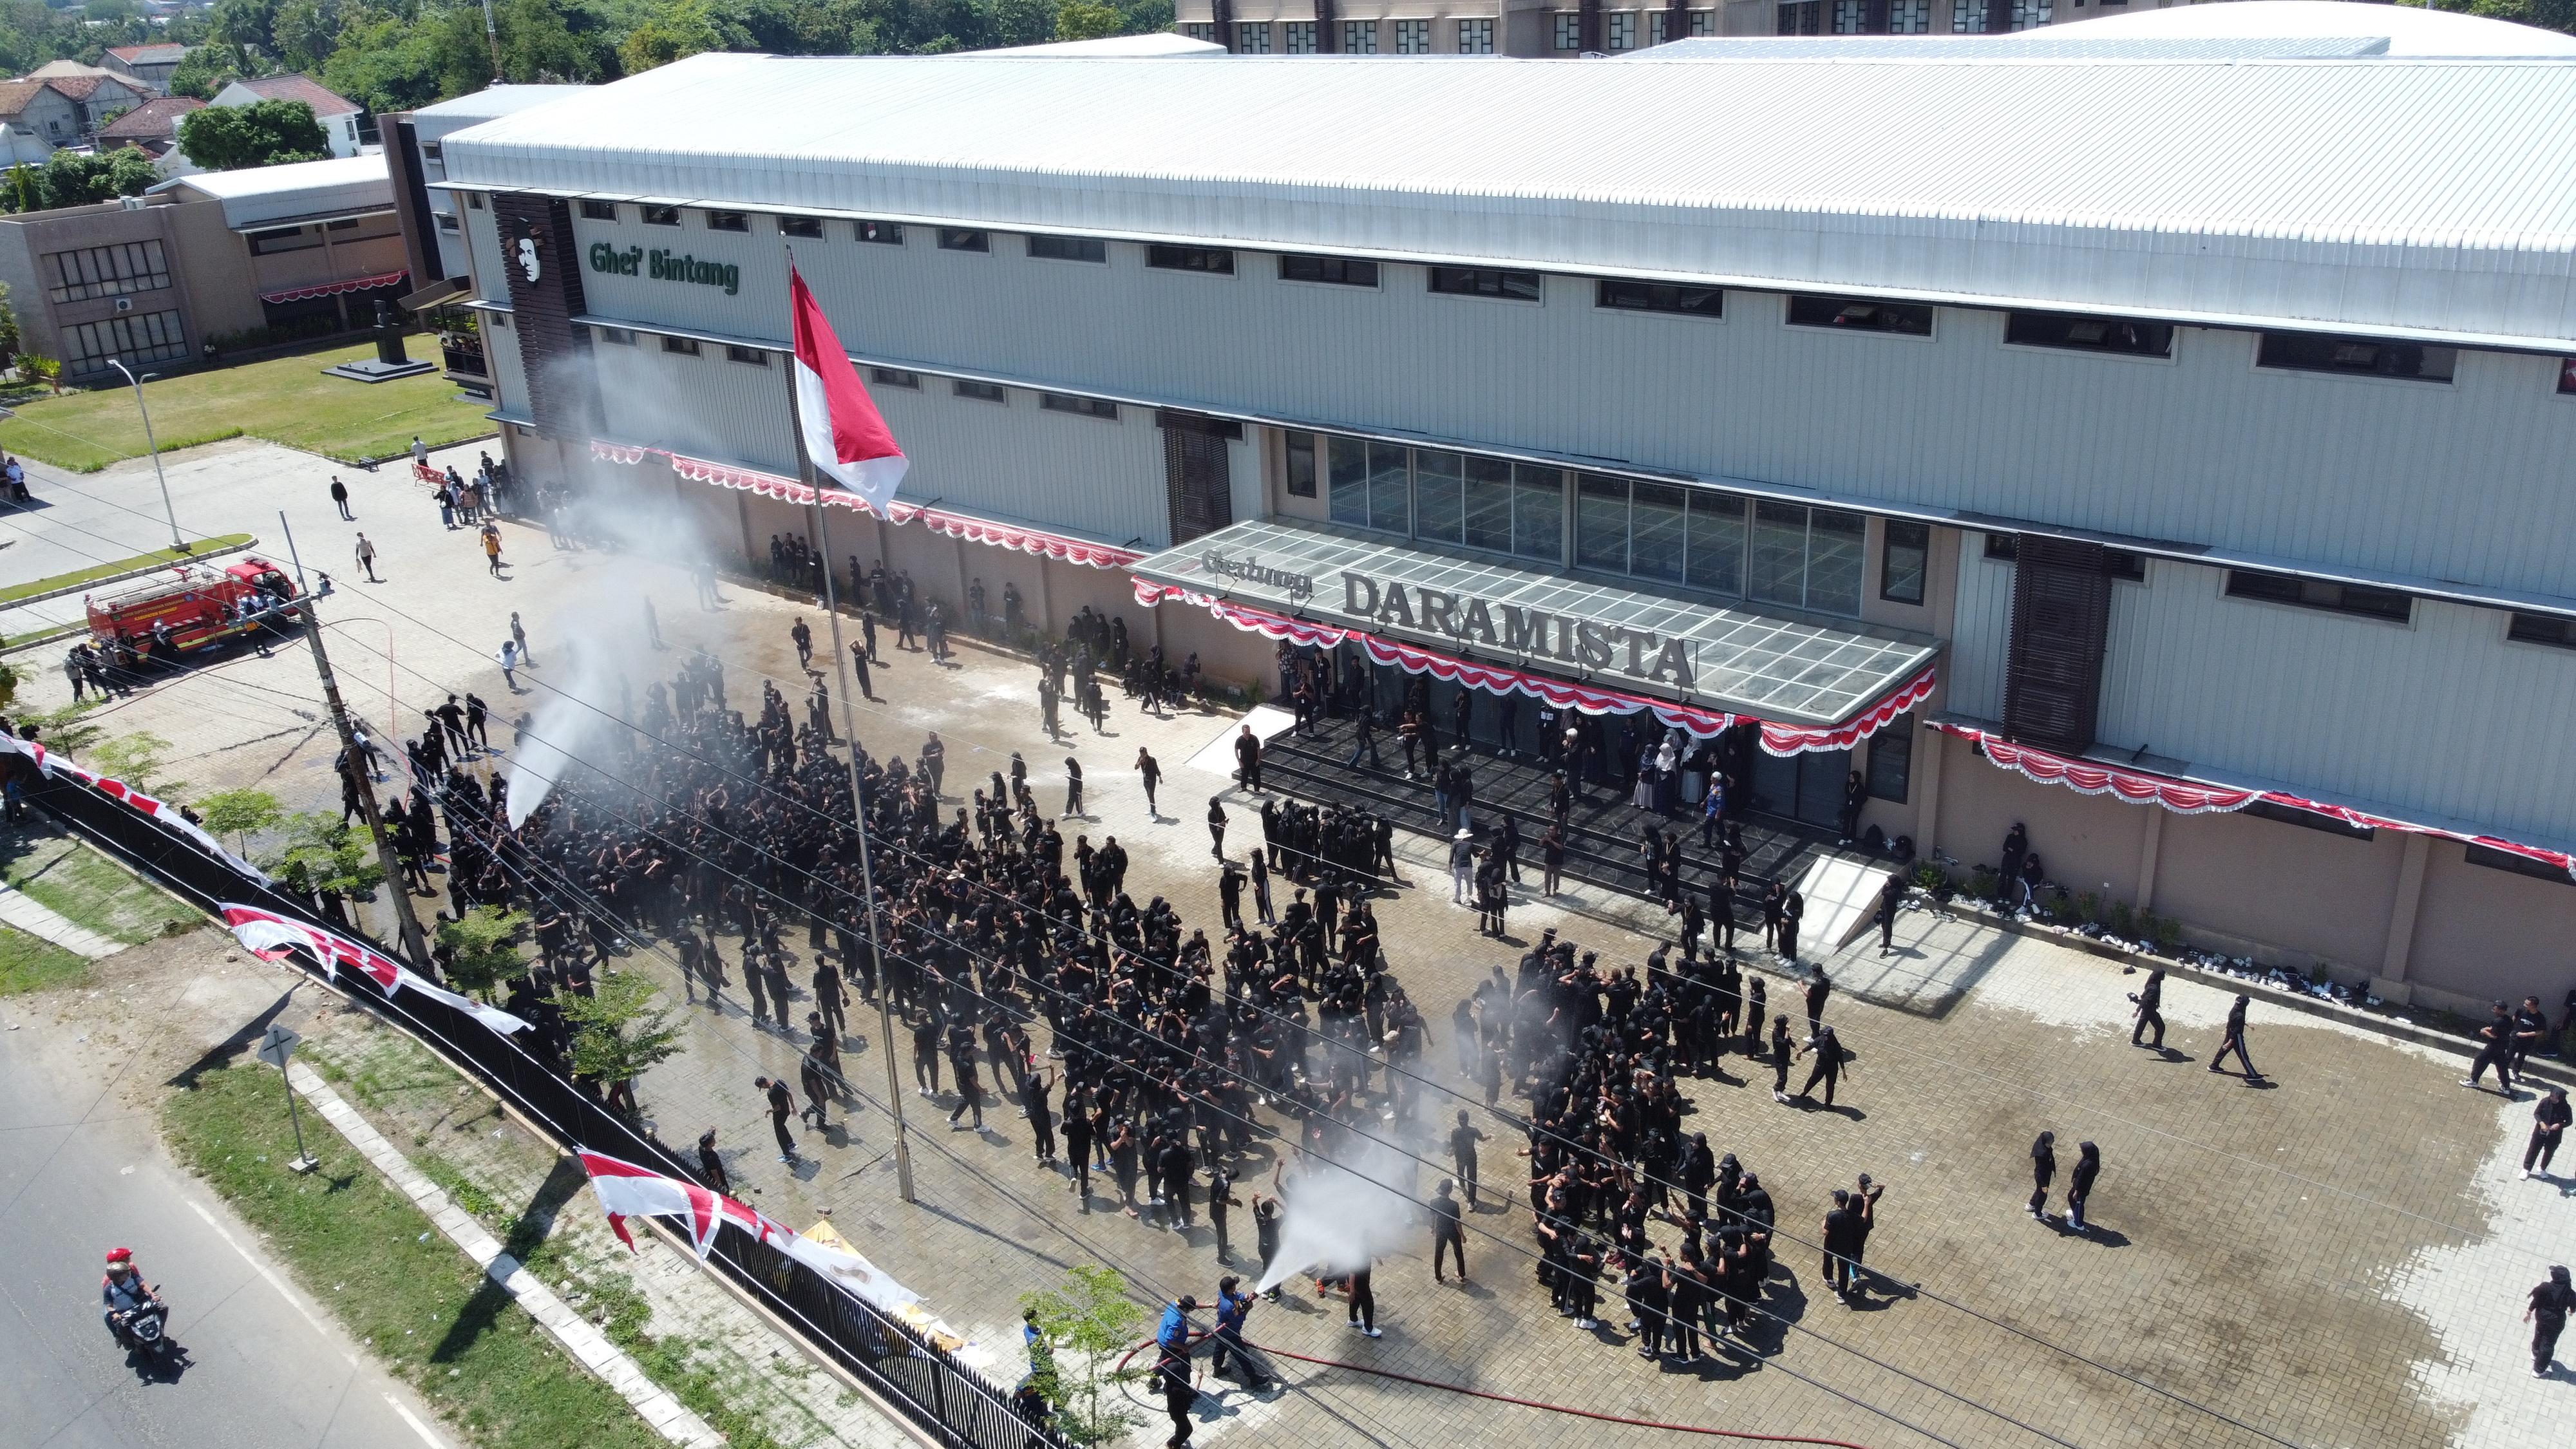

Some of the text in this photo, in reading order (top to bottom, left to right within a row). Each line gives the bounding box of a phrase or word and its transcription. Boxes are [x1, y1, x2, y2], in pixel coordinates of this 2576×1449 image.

[649, 249, 739, 296] Bintang
[1202, 549, 1312, 600] Gedung
[1341, 571, 1696, 690] DARAMISTA
